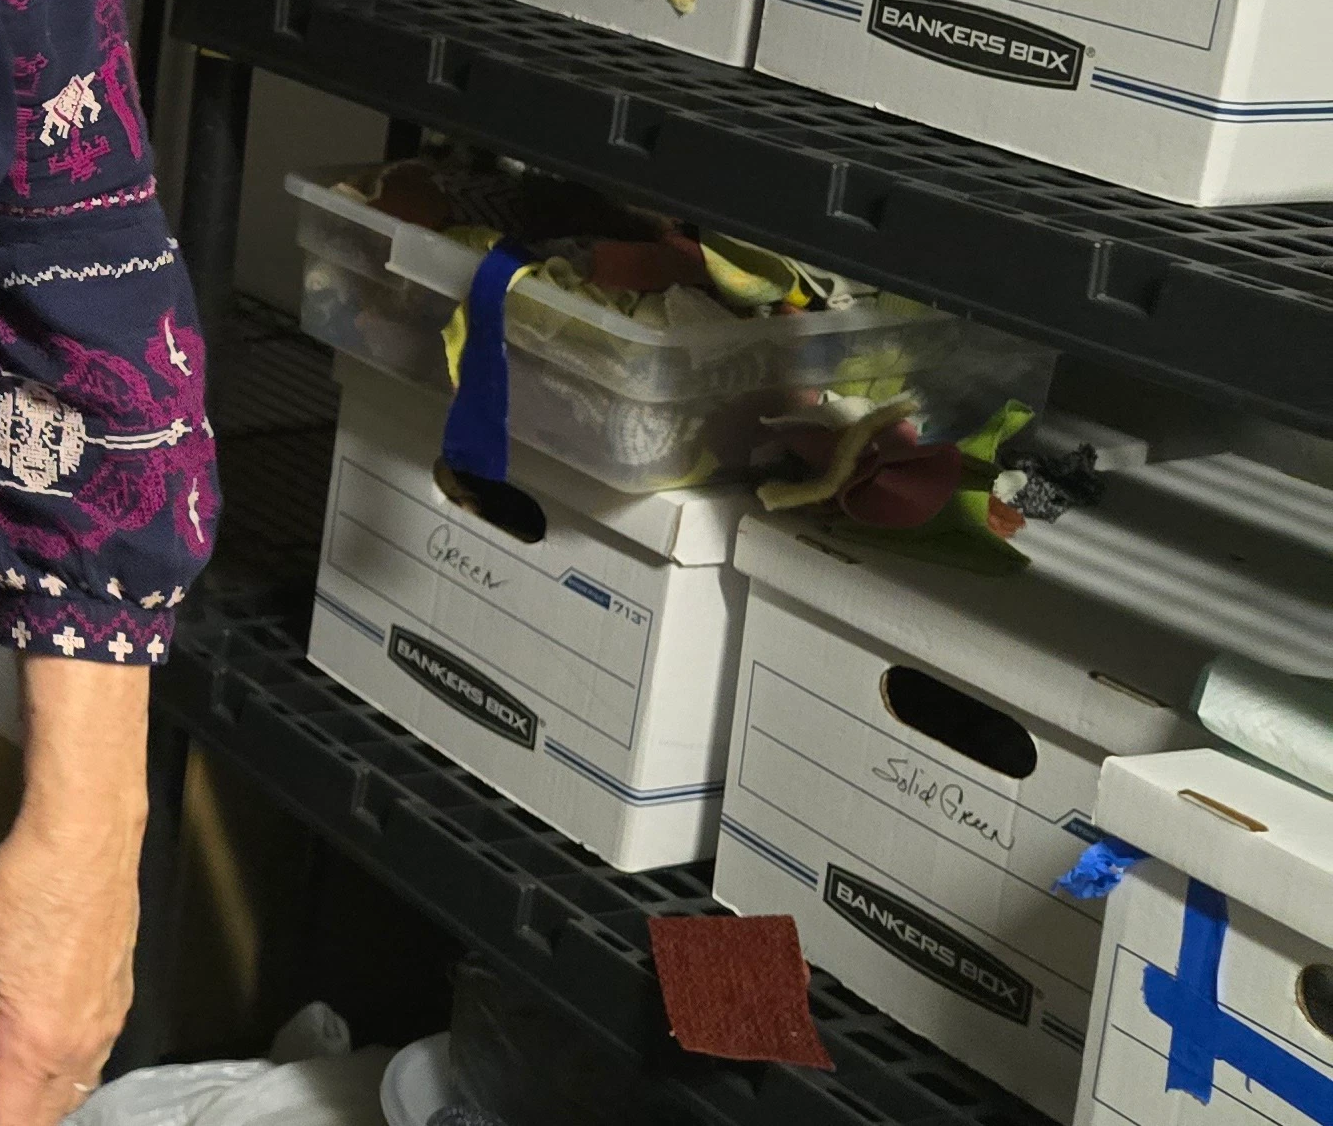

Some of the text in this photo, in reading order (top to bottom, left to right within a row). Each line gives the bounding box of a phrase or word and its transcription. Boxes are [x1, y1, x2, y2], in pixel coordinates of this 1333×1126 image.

[881, 5, 1070, 74] BANKERS BOX
[397, 638, 529, 736] BANKERS BOX
[872, 757, 938, 809] Solid
[836, 881, 1020, 1006] BANKERS BOX
